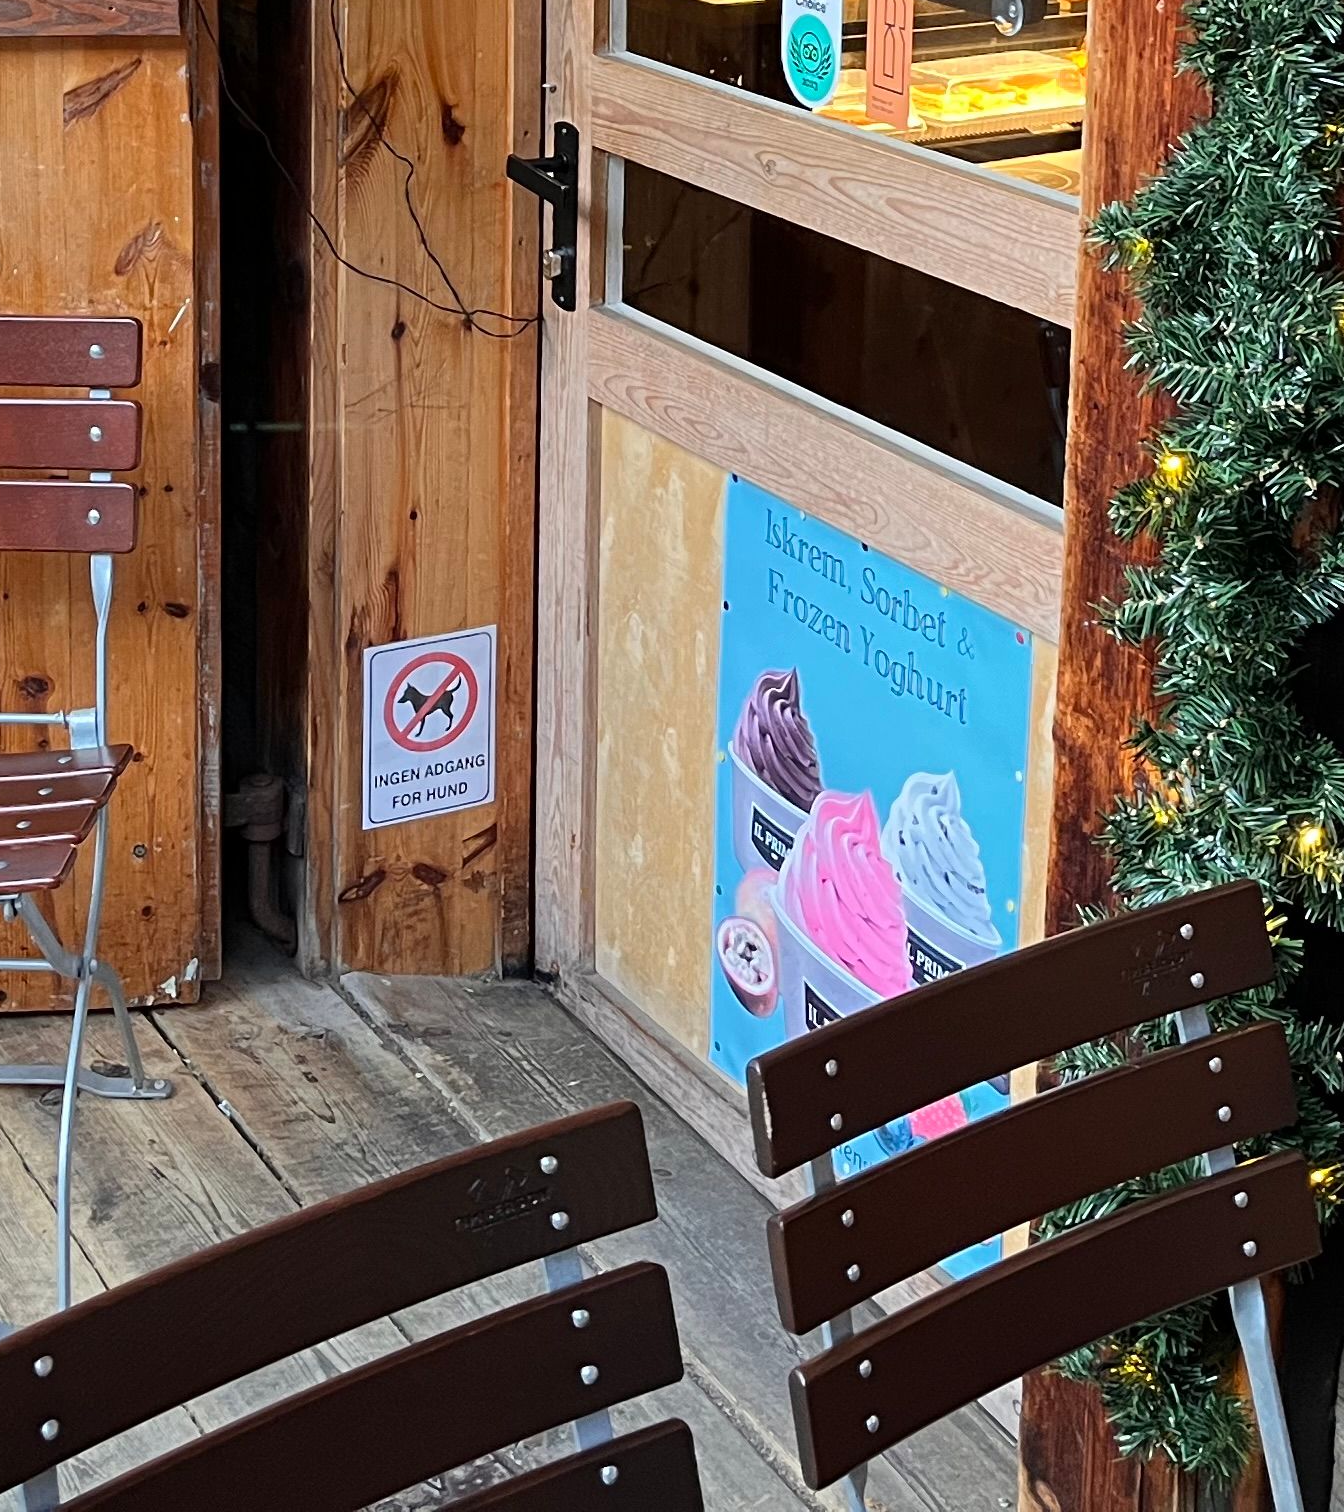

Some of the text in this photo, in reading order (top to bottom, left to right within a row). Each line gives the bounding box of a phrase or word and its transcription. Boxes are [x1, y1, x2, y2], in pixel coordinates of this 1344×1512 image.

[764, 507, 975, 660] Iskrem, Sorbet &
[767, 567, 967, 725] Frozen Yoghurt
[373, 753, 486, 790] INGEN ADGANG
[391, 781, 468, 809] FOR HUND
[753, 821, 791, 858] IL PRIM
[915, 949, 951, 980] PRIM
